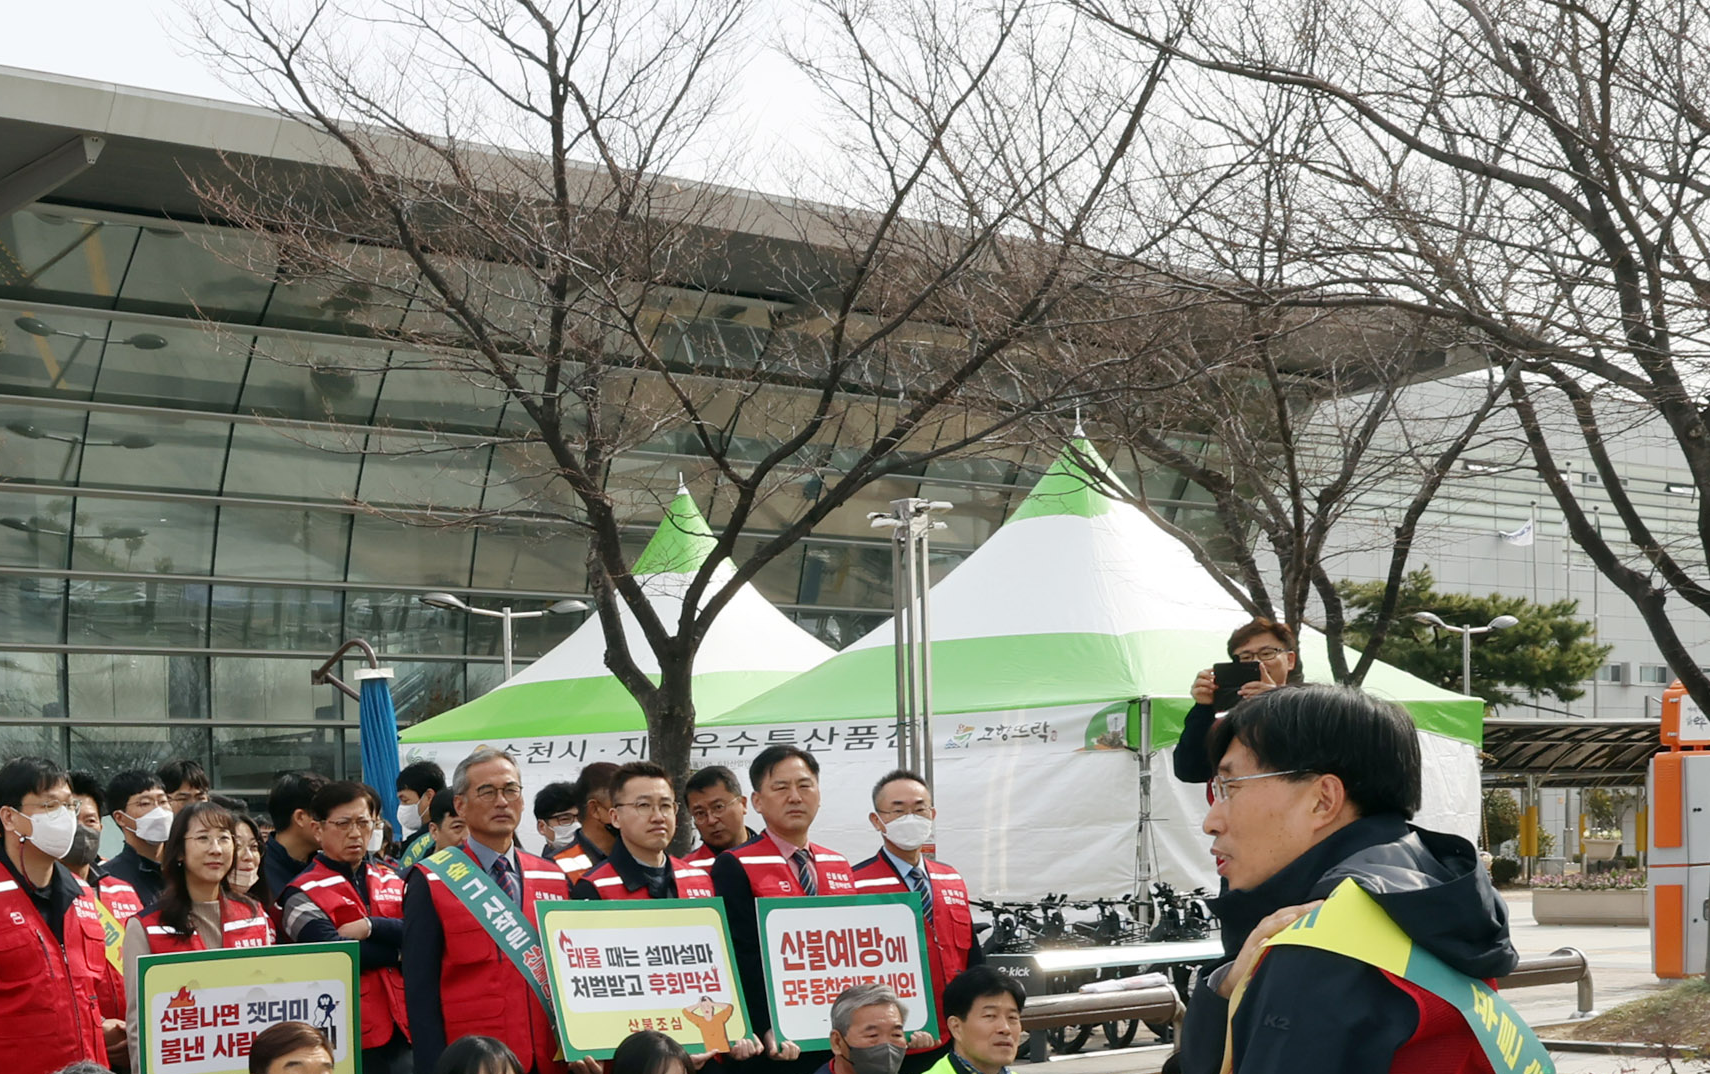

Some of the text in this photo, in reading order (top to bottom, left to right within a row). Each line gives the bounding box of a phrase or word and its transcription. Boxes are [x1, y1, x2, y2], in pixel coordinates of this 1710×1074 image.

[462, 877, 489, 901] 그
[482, 895, 531, 951] 시작은
[566, 943, 714, 969] 태울 때는 설마설마
[780, 926, 908, 971] 산불예방에
[571, 968, 722, 998] 처벌받고 후회막심
[782, 978, 808, 1006] 모두
[160, 998, 309, 1033] 산불나면 잿더미
[628, 1016, 683, 1032] 산불조심
[1471, 983, 1524, 1071] 푸른
[161, 1040, 205, 1066] 불낸
